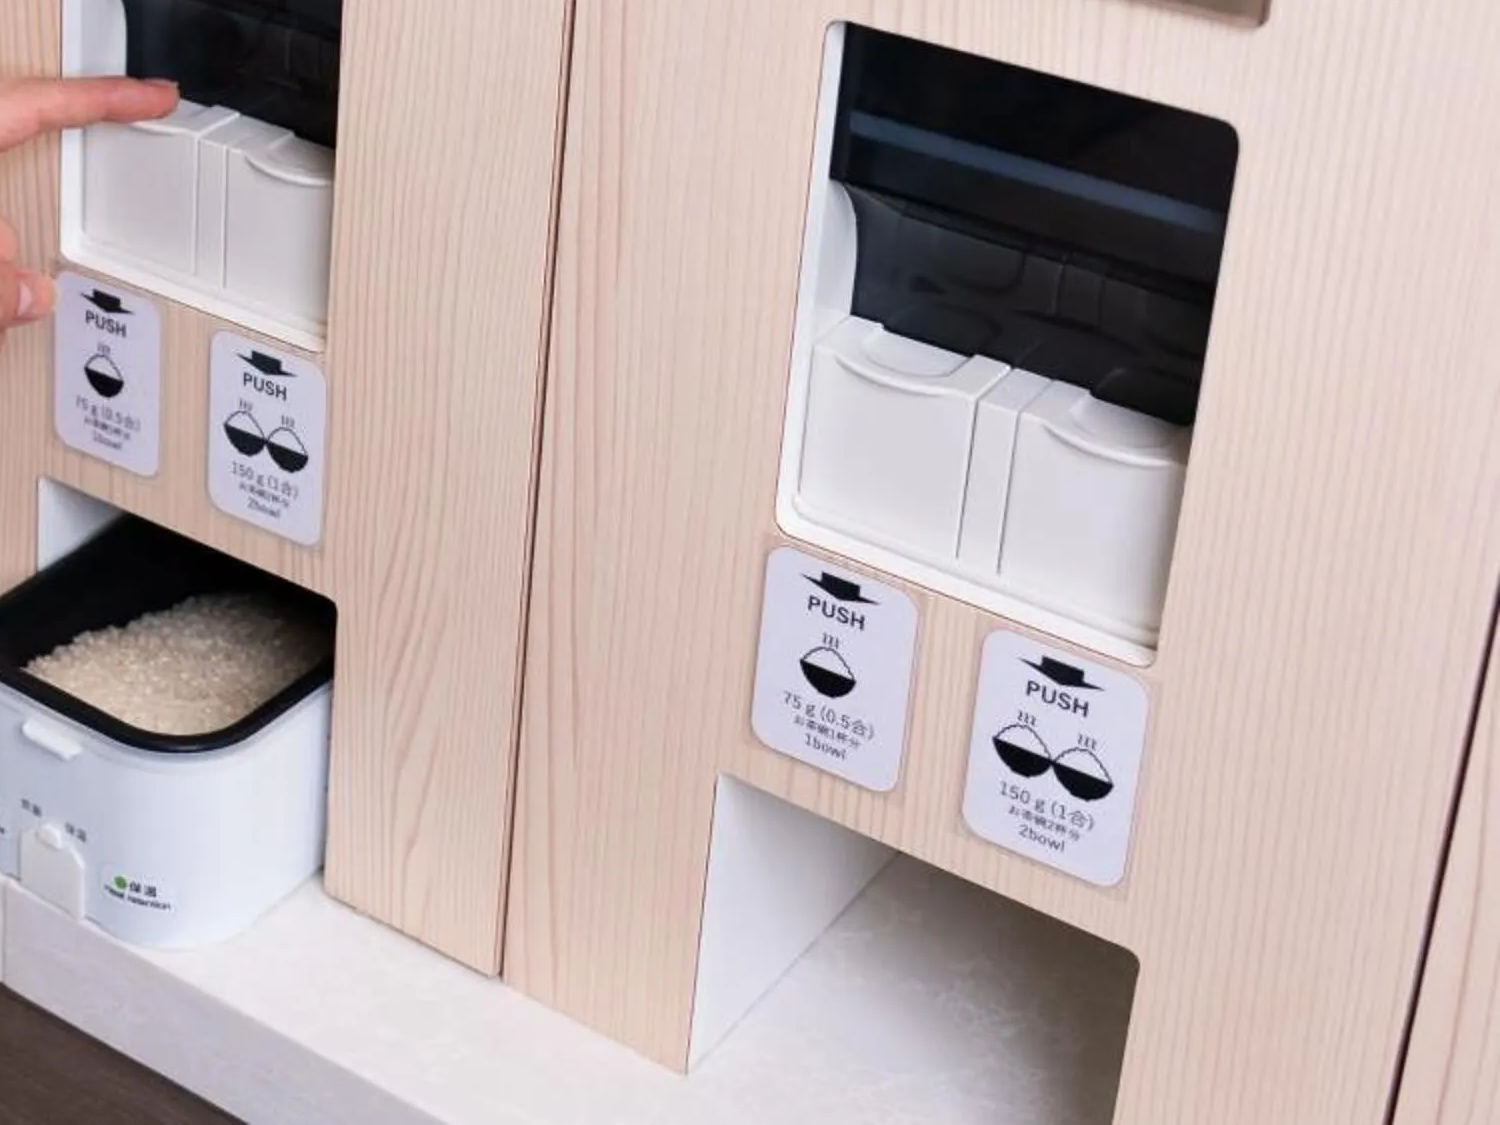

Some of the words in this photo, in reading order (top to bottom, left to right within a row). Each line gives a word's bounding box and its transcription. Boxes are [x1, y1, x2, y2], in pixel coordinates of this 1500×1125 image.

[84, 309, 127, 338] PUSH
[242, 371, 288, 402] PUSH
[806, 595, 866, 632] PUSH
[1025, 679, 1090, 719] PUSH
[804, 733, 847, 761] 1bowl
[1018, 824, 1066, 852] 2bowl
